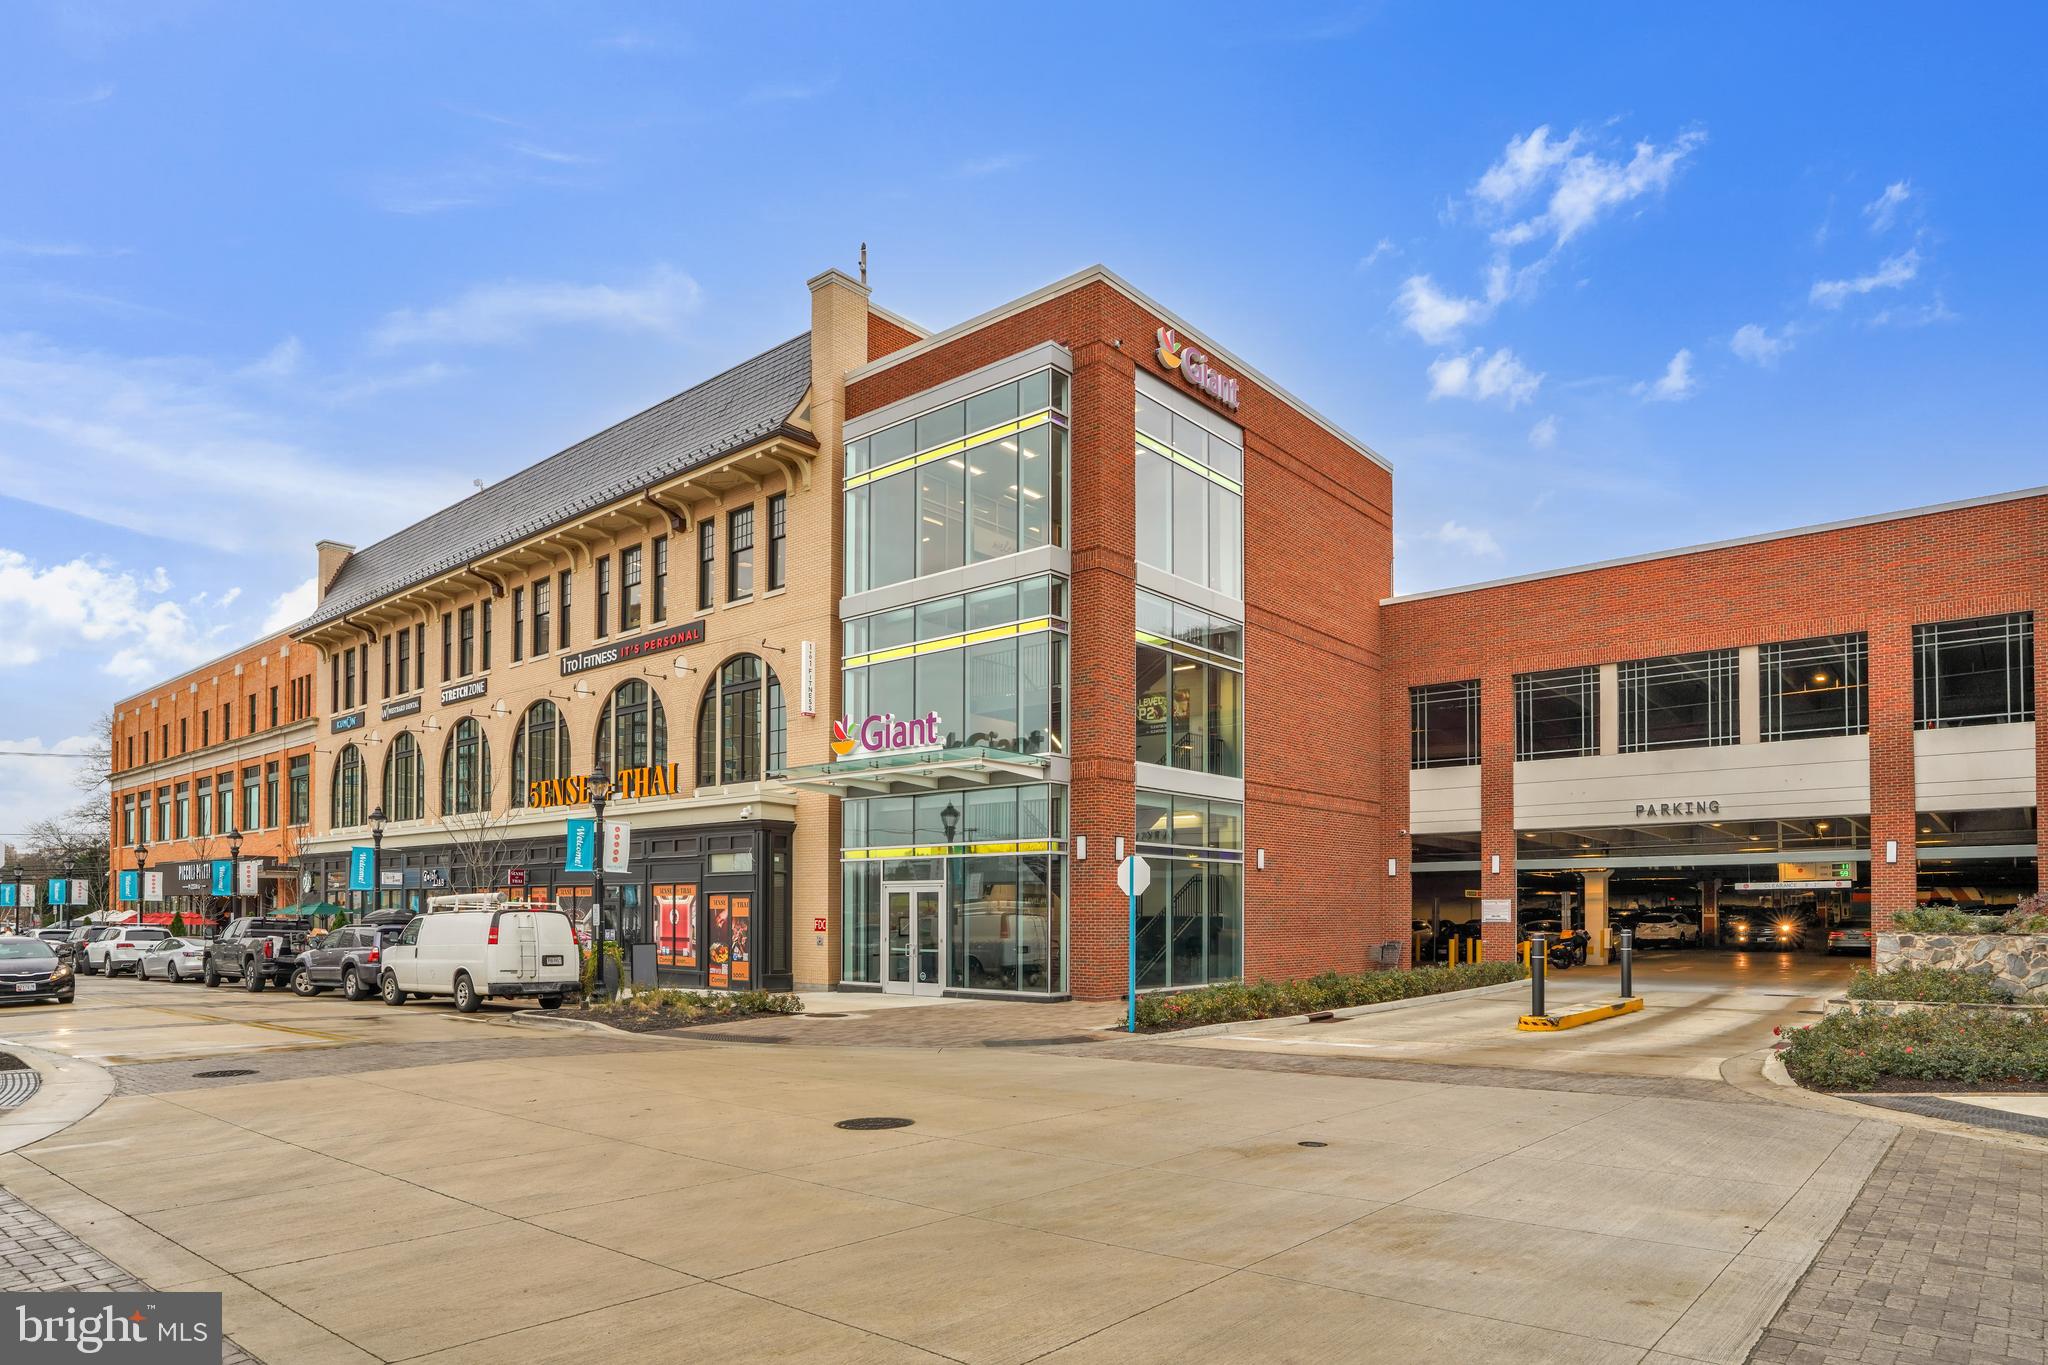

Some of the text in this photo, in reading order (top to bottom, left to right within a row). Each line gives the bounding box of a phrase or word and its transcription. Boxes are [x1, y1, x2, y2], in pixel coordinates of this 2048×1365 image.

[1181, 347, 1239, 411] Giant
[620, 629, 700, 657] IT'S PERSONAL
[583, 649, 618, 668] FITNESS
[441, 681, 485, 703] STRETCH ZONE
[336, 716, 357, 729] KUMON
[1139, 707, 1156, 721] P2
[861, 711, 943, 752] Giant
[617, 762, 679, 800] THAI
[1635, 800, 1720, 818] PARKING
[574, 826, 585, 868] Welcome!
[358, 852, 367, 885] Welcome!
